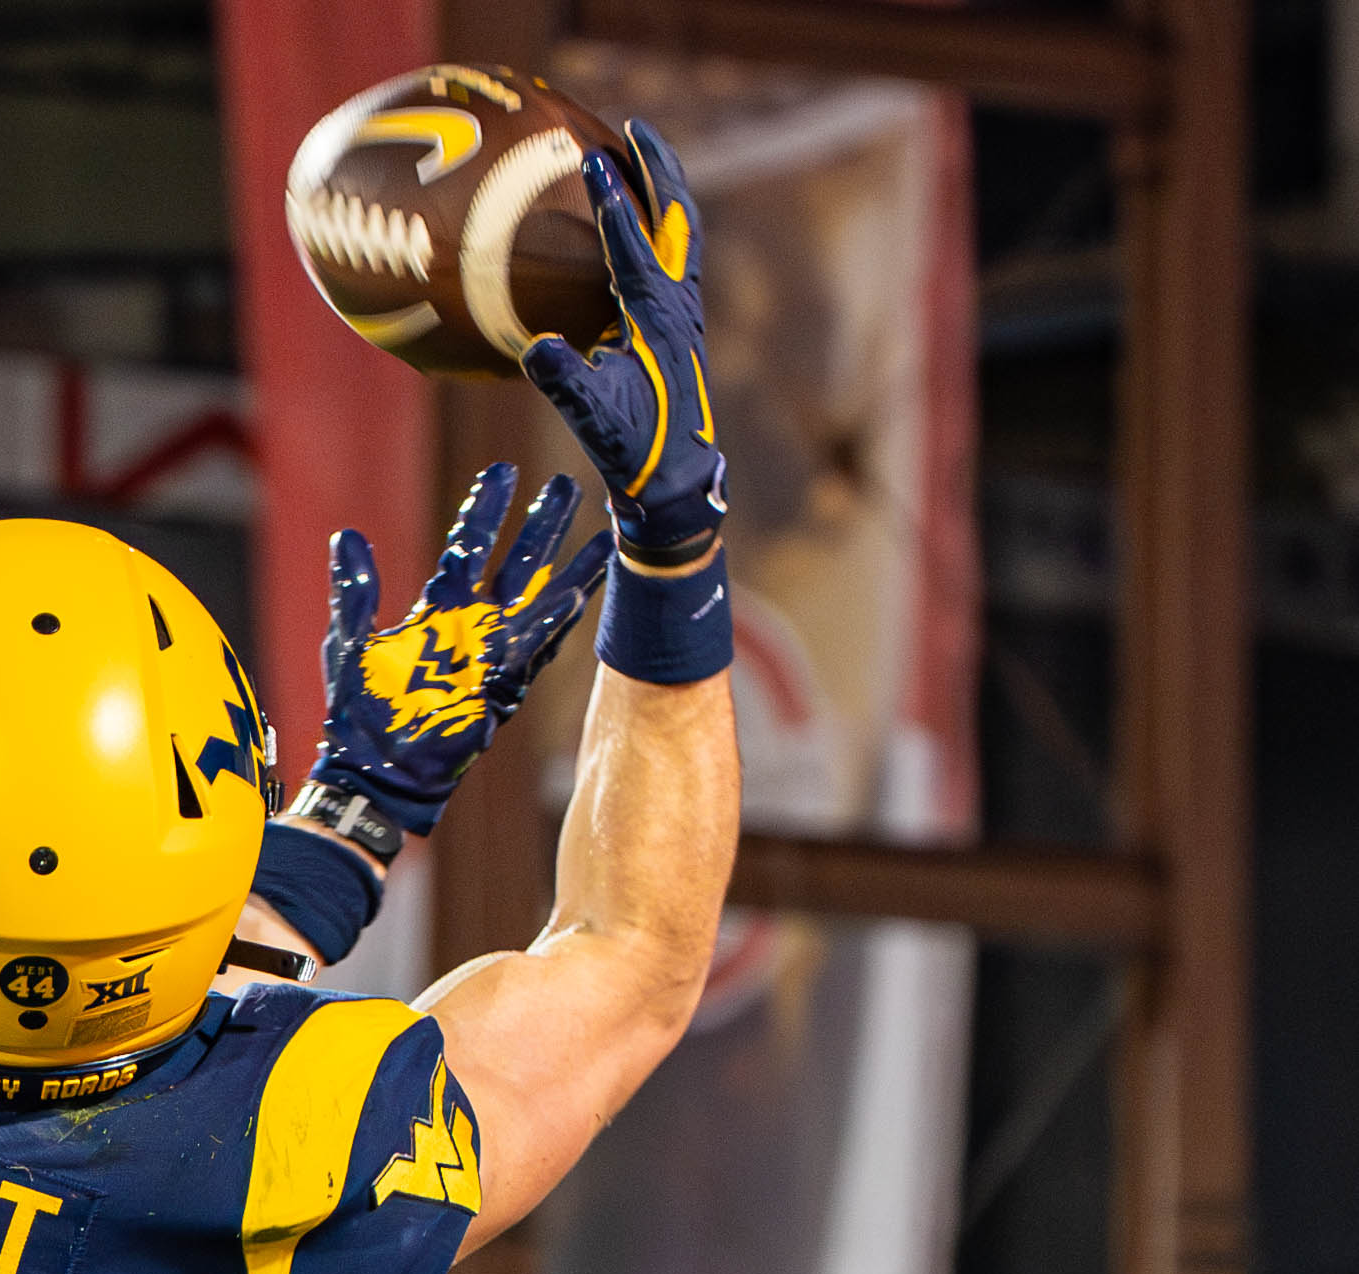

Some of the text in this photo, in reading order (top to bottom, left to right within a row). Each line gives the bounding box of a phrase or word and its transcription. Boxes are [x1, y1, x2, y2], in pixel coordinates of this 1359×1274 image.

[15, 964, 56, 976] WEST
[6, 975, 56, 1000] 44
[40, 1063, 138, 1100] ROADS
